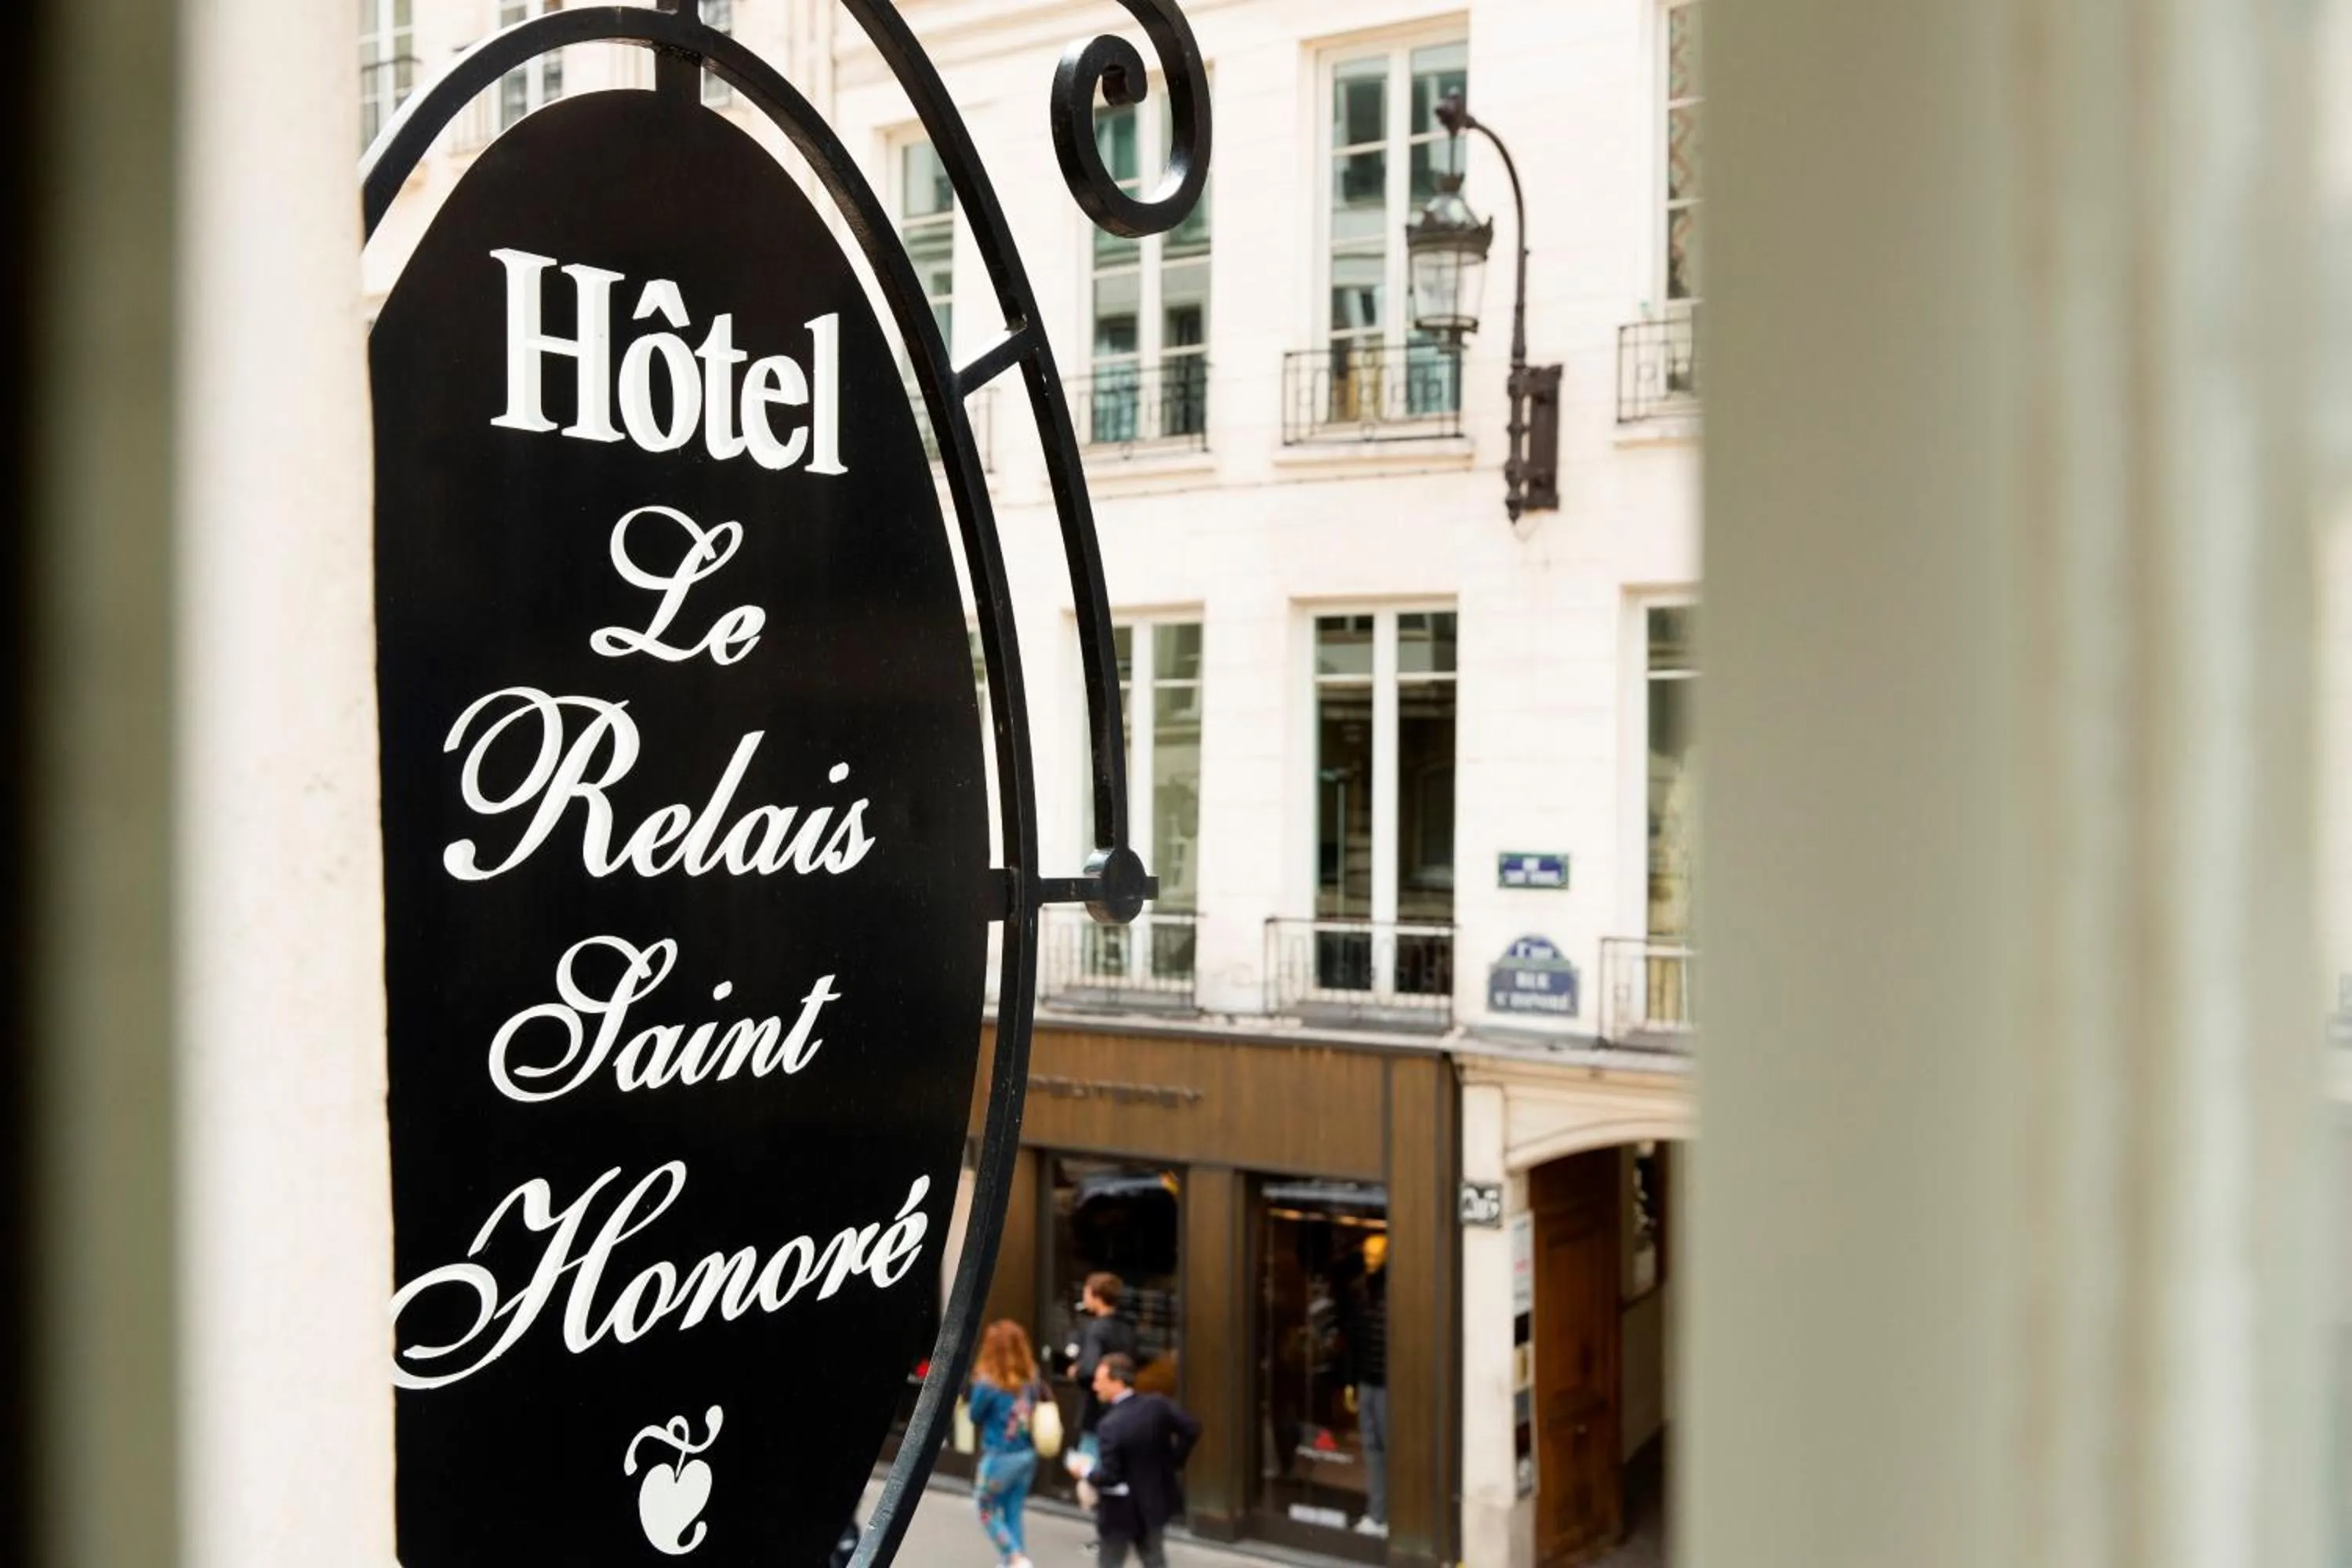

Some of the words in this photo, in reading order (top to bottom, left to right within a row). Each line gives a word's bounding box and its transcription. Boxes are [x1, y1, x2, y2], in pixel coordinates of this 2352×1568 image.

[489, 247, 849, 476] Hôtel
[589, 505, 766, 666] Le
[443, 686, 876, 881] Relais
[488, 935, 841, 1102] Saint
[390, 1160, 931, 1390] Honoré
